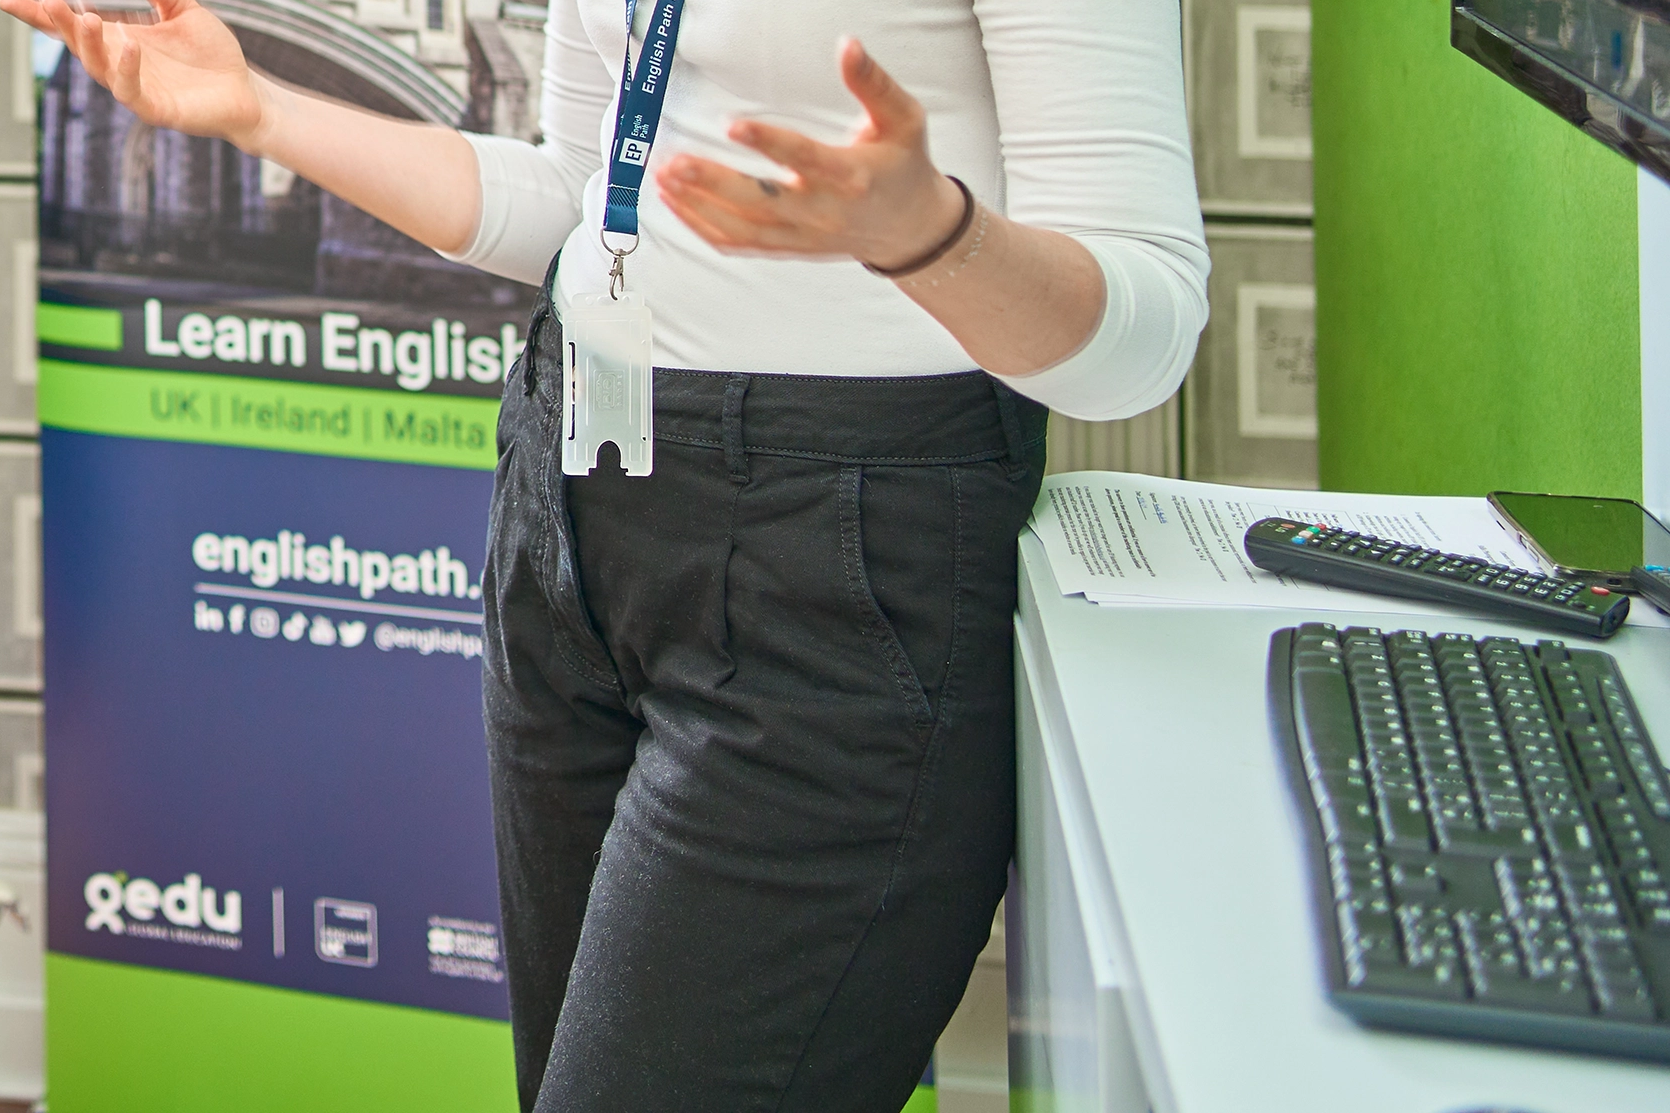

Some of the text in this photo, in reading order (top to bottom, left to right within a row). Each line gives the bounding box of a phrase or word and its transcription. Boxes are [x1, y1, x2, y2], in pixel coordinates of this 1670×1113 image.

[642, 41, 666, 95] English
[657, 3, 674, 37] Path
[624, 142, 643, 161] EP
[144, 297, 307, 368] Learn
[150, 388, 202, 423] UK
[231, 394, 351, 438] Ireland
[384, 407, 487, 451] Malta
[192, 529, 485, 600] englishpath.
